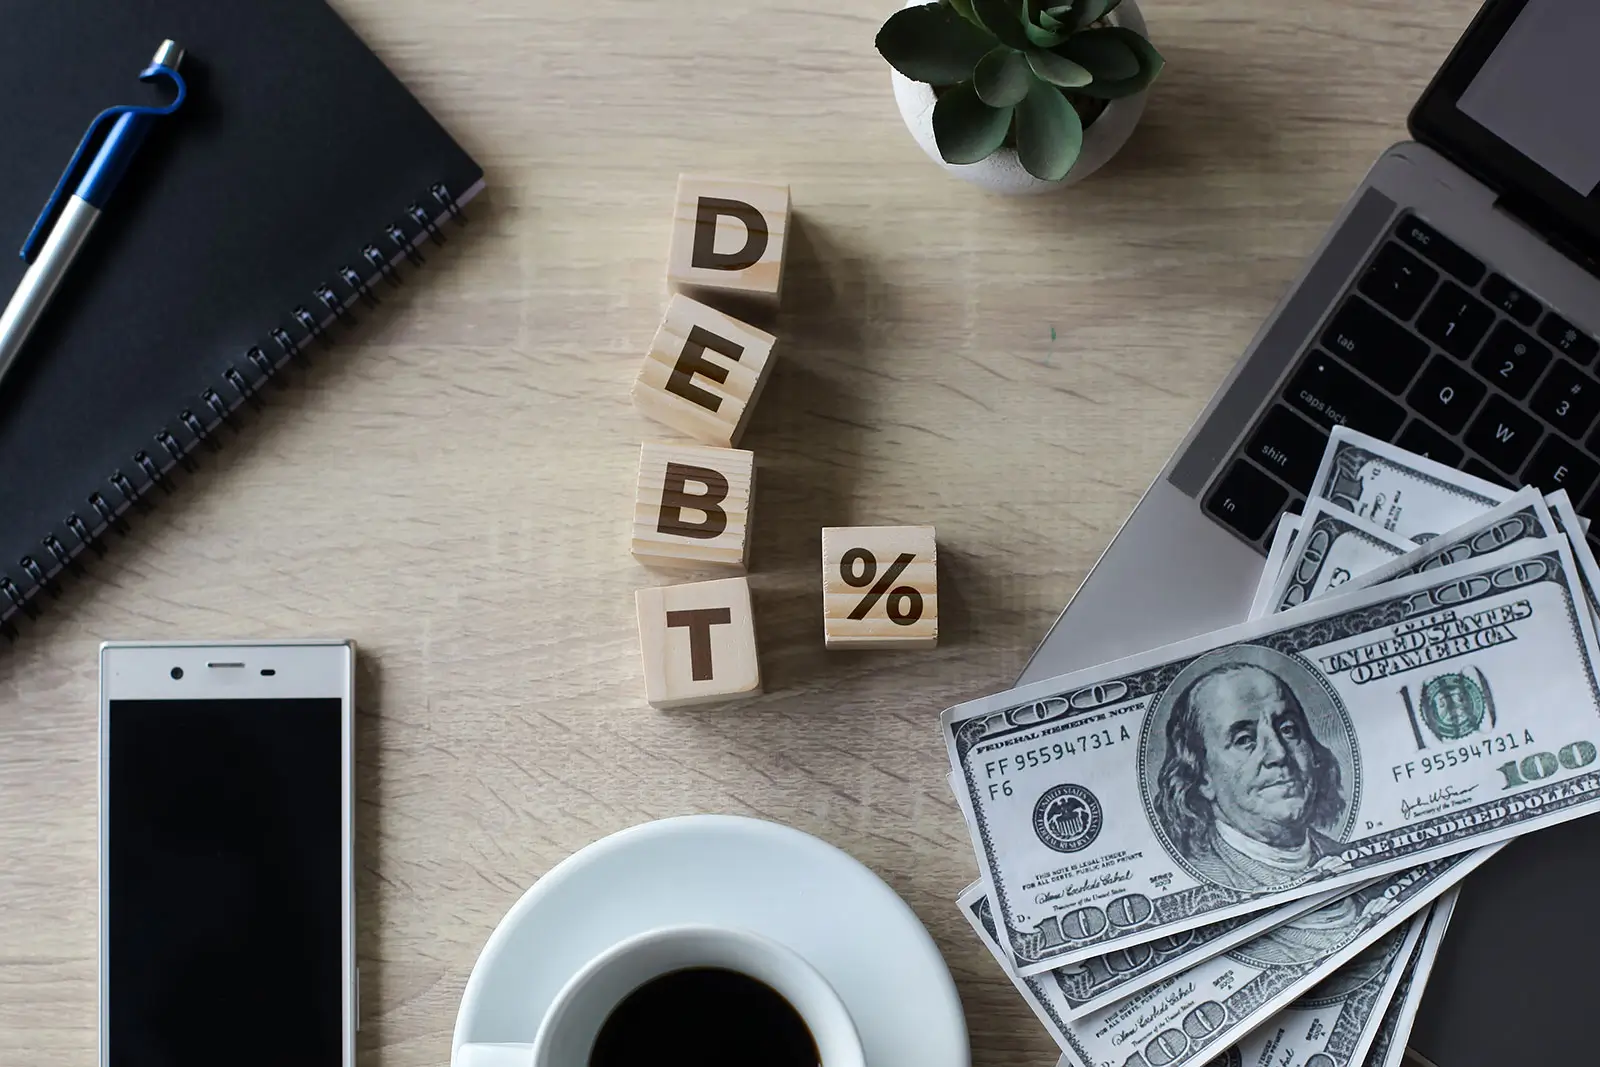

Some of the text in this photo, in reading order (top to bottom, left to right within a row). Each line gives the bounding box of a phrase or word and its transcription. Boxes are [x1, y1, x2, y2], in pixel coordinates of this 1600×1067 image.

[1411, 228, 1431, 245] esc
[1445, 321, 1456, 337] 1
[1336, 333, 1356, 352] tab
[1499, 360, 1515, 378] 2
[1439, 386, 1455, 405] Q
[1299, 389, 1348, 426] caps lock
[1555, 400, 1571, 417] 3
[1495, 423, 1516, 444] W
[1261, 444, 1289, 468] shift
[1553, 465, 1569, 483] E
[1223, 497, 1236, 513] fn
[1319, 599, 1533, 675] UNITED STATES
[1350, 624, 1518, 685] OF AMERICA
[976, 702, 1146, 755] FEDERAL RESERVE NOTE
[1495, 739, 1598, 791] 100
[988, 780, 1013, 802] F6
[1340, 840, 1390, 862] ONE
[1392, 806, 1508, 849] HUNDRED
[1033, 892, 1155, 950] 100
